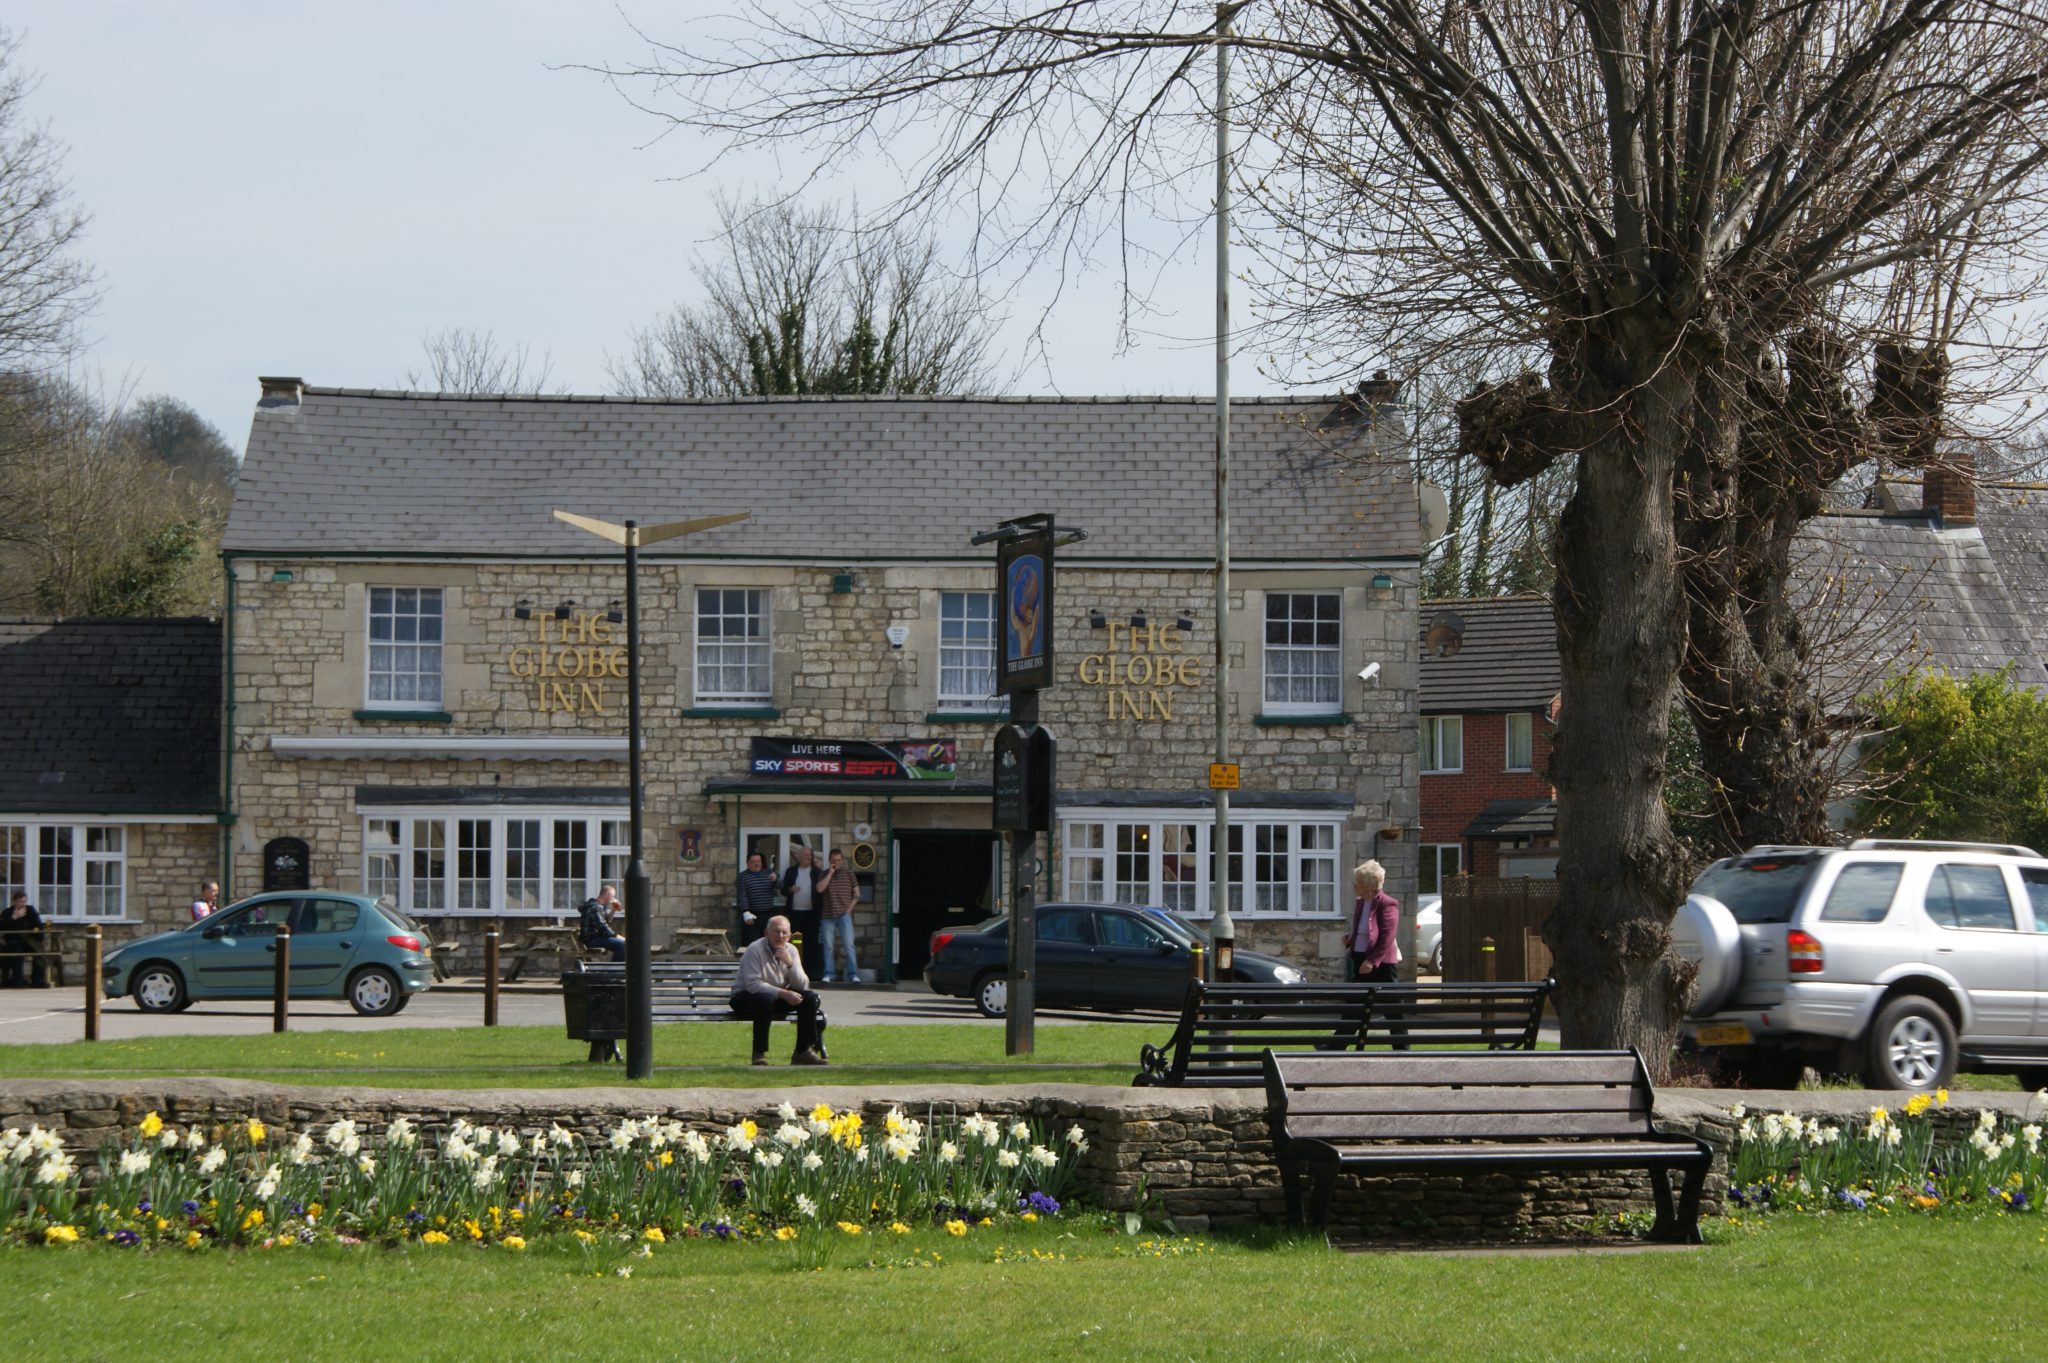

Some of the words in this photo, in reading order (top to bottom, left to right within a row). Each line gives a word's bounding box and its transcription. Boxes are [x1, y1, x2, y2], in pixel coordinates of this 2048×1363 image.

[530, 613, 612, 643] THE
[1105, 622, 1183, 652] THE
[509, 647, 630, 677] GLOBE
[1079, 655, 1201, 686] GLOBE
[538, 682, 603, 712] INN
[1107, 690, 1174, 720] INN
[791, 744, 813, 754] LIVE
[816, 745, 842, 755] HERE
[755, 760, 783, 771] SKY
[785, 761, 840, 772] SPORTS
[845, 761, 897, 775] ESPN
